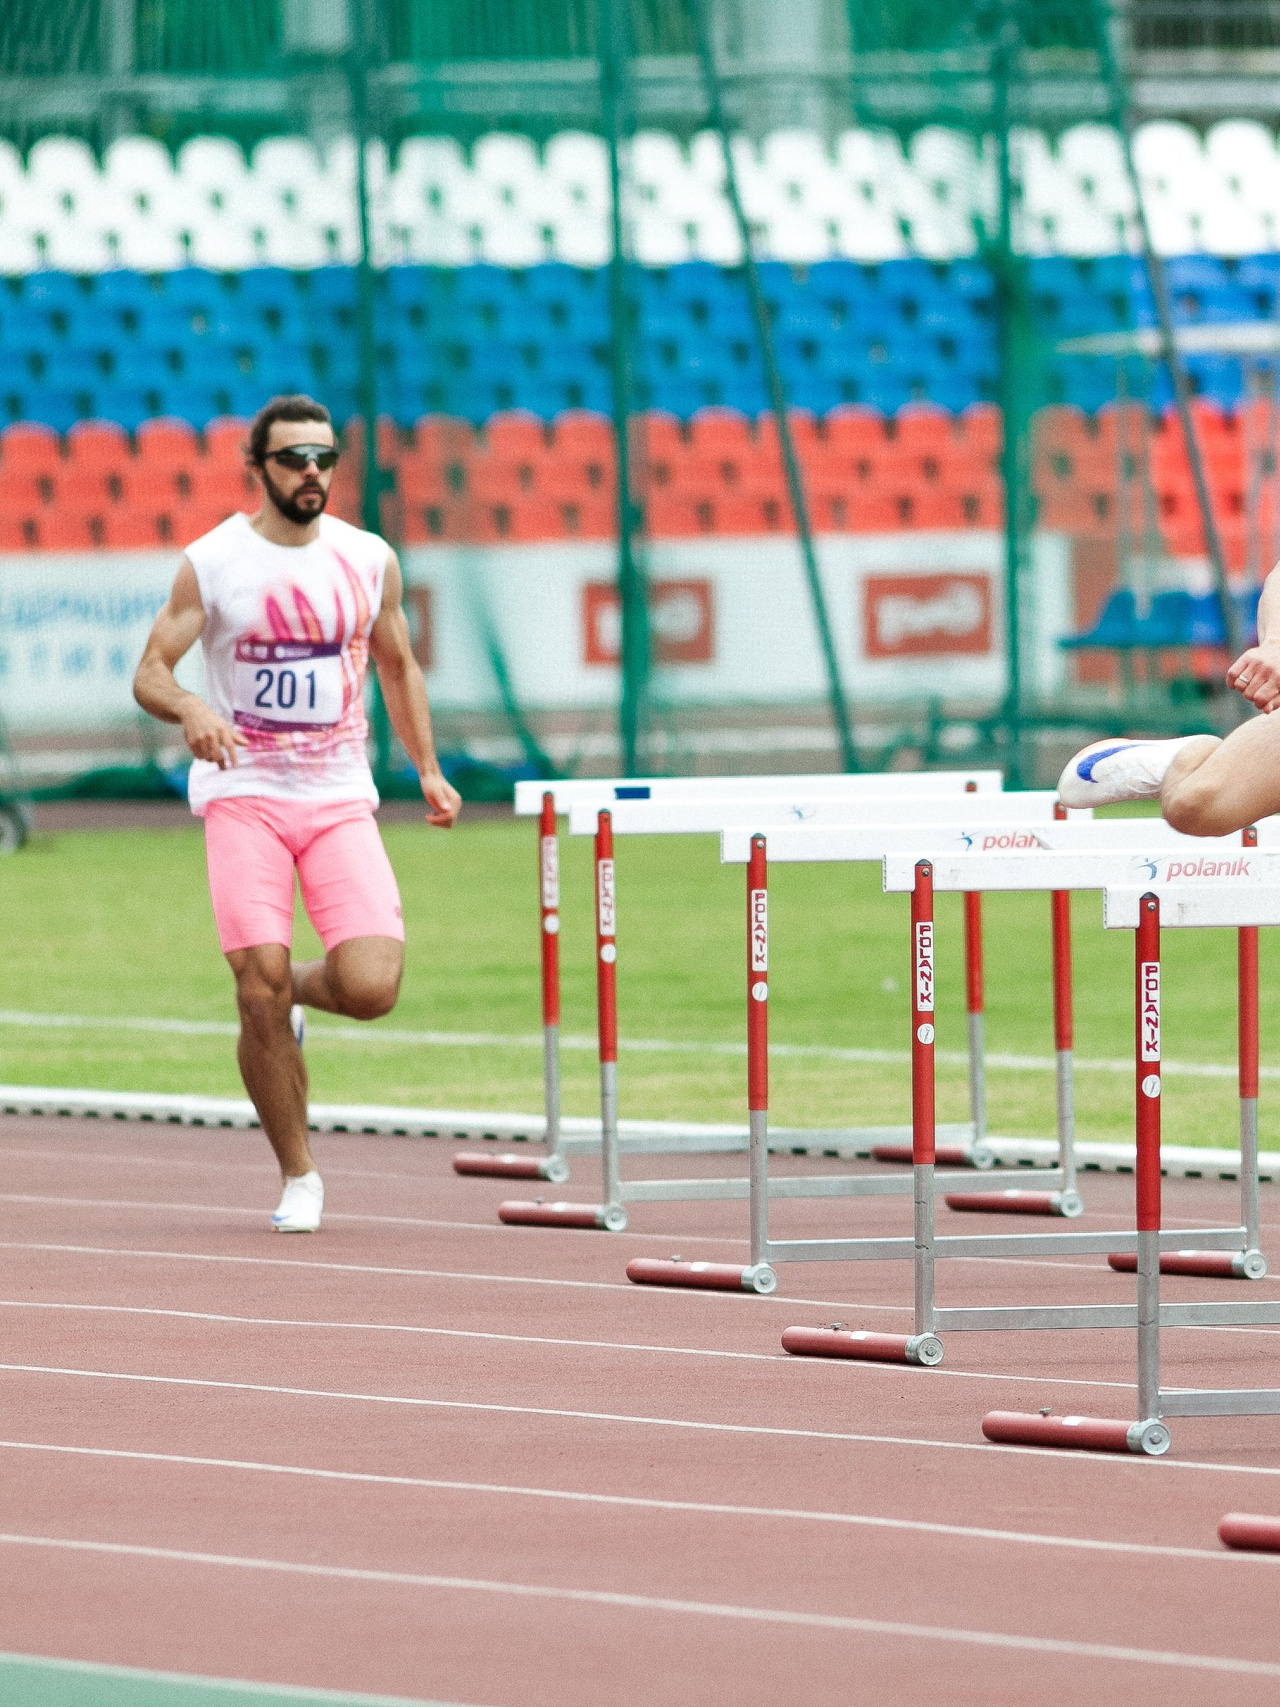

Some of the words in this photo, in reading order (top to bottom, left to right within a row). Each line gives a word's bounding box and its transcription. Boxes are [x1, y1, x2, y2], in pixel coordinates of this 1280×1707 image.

[255, 668, 315, 709] 201
[1166, 857, 1251, 882] polanik
[754, 892, 767, 963] POLANIK
[918, 925, 933, 1003] POLANIK
[1143, 965, 1160, 1053] POLANIK
